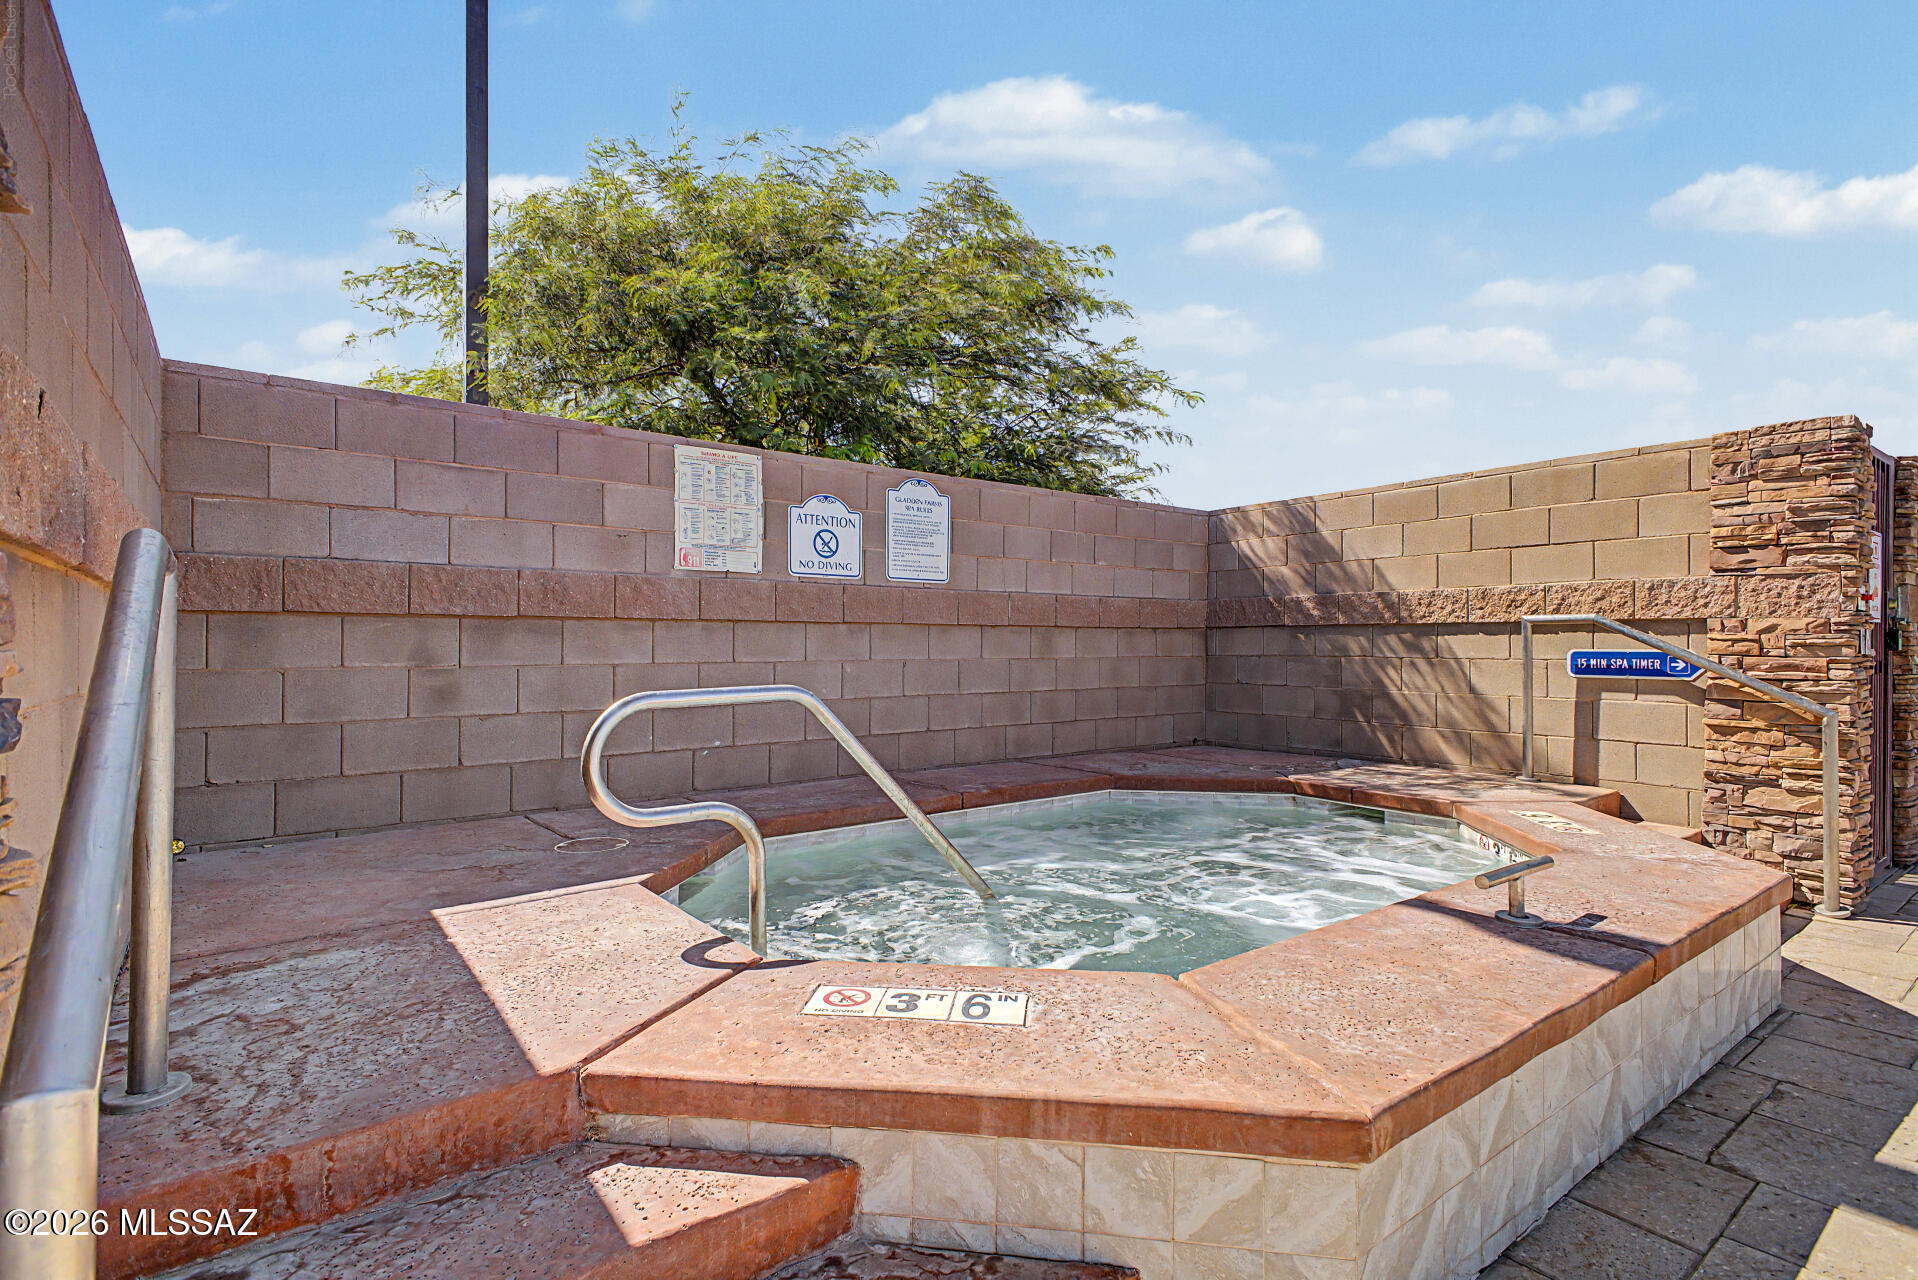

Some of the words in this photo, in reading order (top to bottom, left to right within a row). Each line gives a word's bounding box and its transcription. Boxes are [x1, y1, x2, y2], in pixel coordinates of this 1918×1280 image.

[795, 512, 856, 529] ATTENTION
[799, 559, 815, 569] NO
[818, 560, 852, 572] DIVING
[1577, 658, 1587, 669] 15
[1590, 658, 1608, 669] MIN
[1610, 658, 1629, 669] SPA
[1632, 658, 1661, 670] TIMER
[885, 993, 921, 1013] 3
[925, 993, 949, 1002] FT
[961, 994, 992, 1020] 6
[998, 994, 1019, 1003] IN
